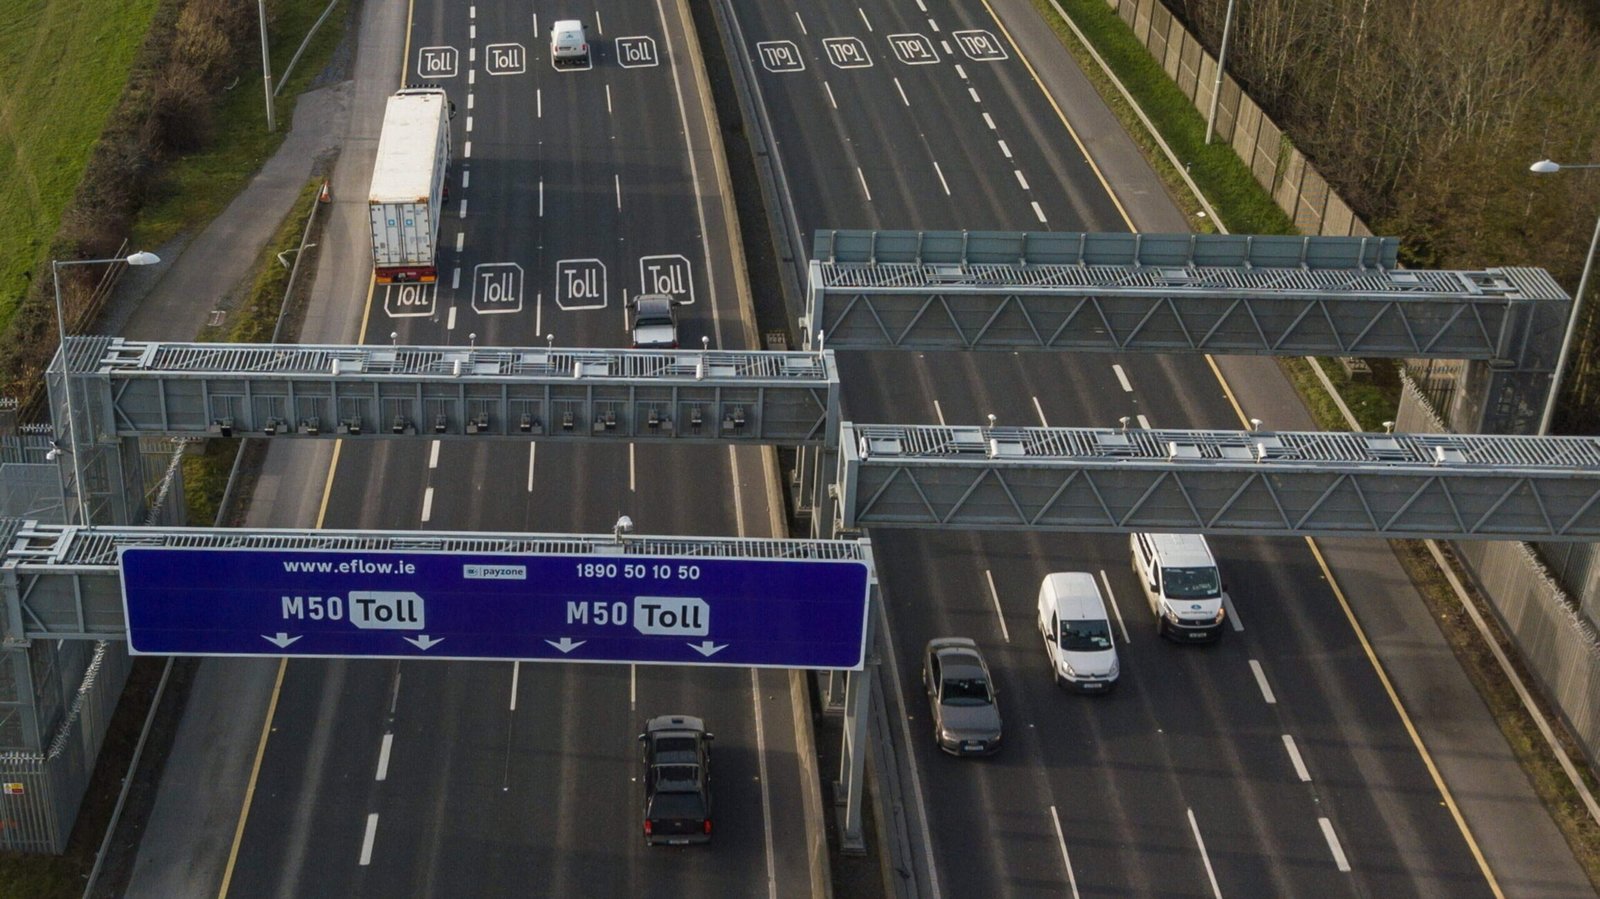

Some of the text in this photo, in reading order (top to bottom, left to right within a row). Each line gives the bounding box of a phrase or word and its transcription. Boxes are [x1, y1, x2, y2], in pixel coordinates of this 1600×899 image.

[622, 42, 652, 61] Toll
[830, 43, 865, 62] Toll
[896, 40, 932, 58] Toll
[961, 36, 999, 54] Toll
[425, 52, 452, 72] Toll
[492, 49, 520, 69] Toll
[763, 46, 797, 66] Toll
[481, 272, 515, 303] Toll
[564, 268, 600, 299] Toll
[648, 265, 687, 295] Toll
[283, 559, 416, 574] www.eflow.ie
[483, 568, 524, 578] payzone
[576, 563, 700, 580] 1890 50 10 50
[281, 596, 418, 622] M50 Toll
[566, 601, 703, 629] M50 Toll
